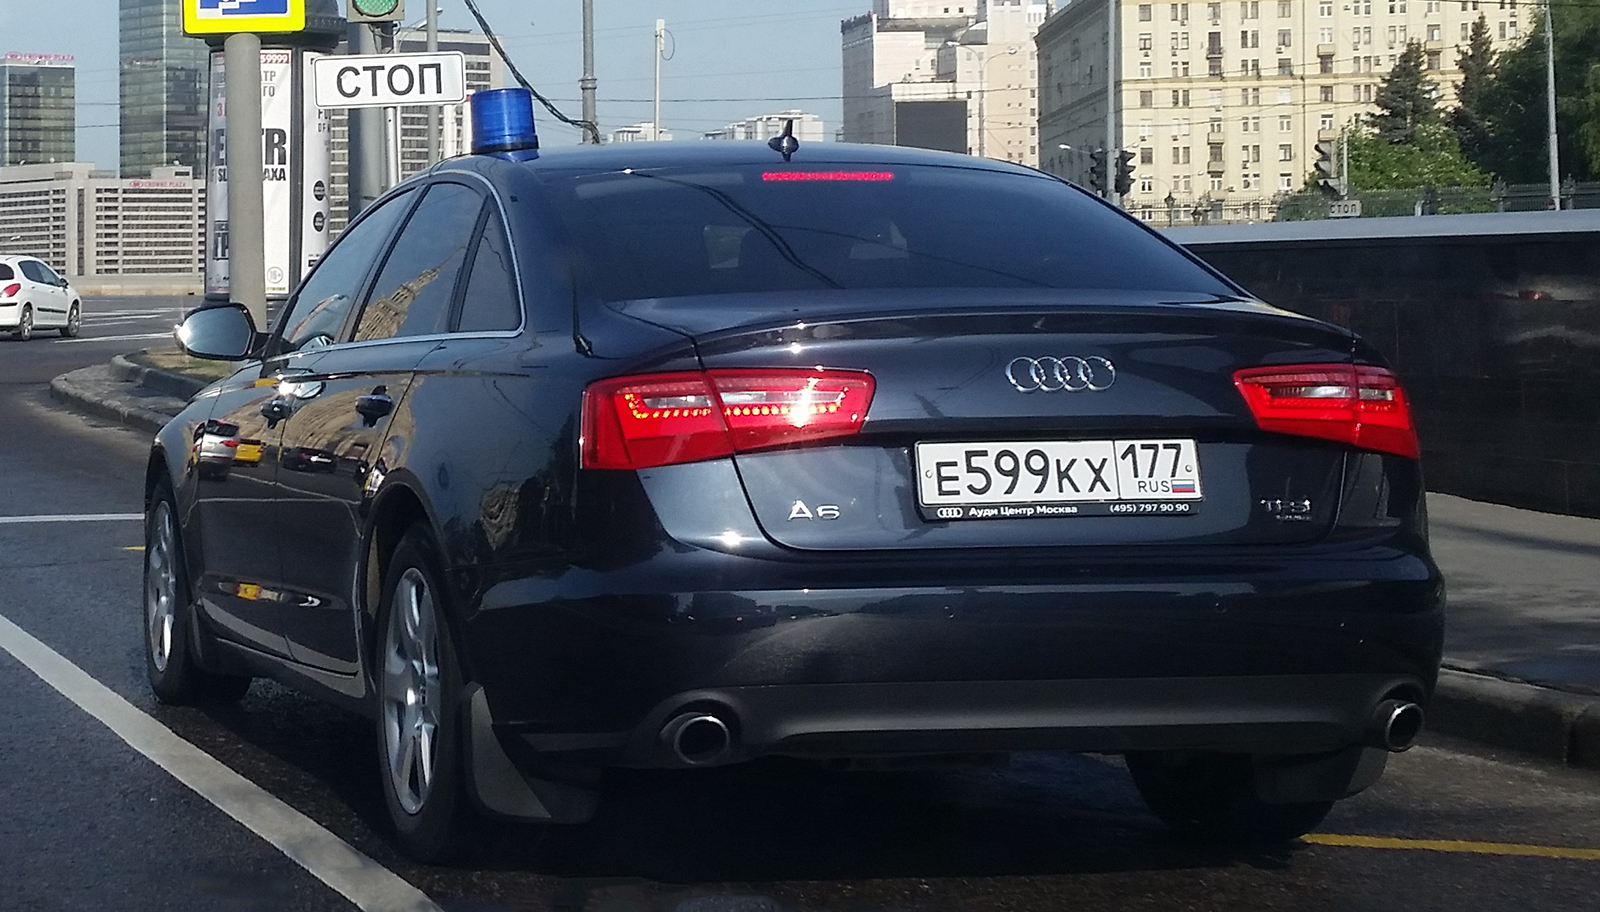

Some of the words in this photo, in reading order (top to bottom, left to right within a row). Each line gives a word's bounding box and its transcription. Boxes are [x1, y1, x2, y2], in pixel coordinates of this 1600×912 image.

[260, 53, 288, 63] 59999
[336, 63, 442, 98] СТОП
[1120, 443, 1182, 479] 177
[1138, 481, 1170, 493] RUS
[787, 500, 840, 521] A6
[968, 507, 998, 518] Ауди
[1000, 506, 1035, 517] Центр
[1036, 505, 1078, 515] Москва
[1109, 503, 1137, 513] (495)
[1139, 503, 1158, 512] 797
[1160, 503, 1174, 512] 90
[1175, 503, 1190, 512] 90
